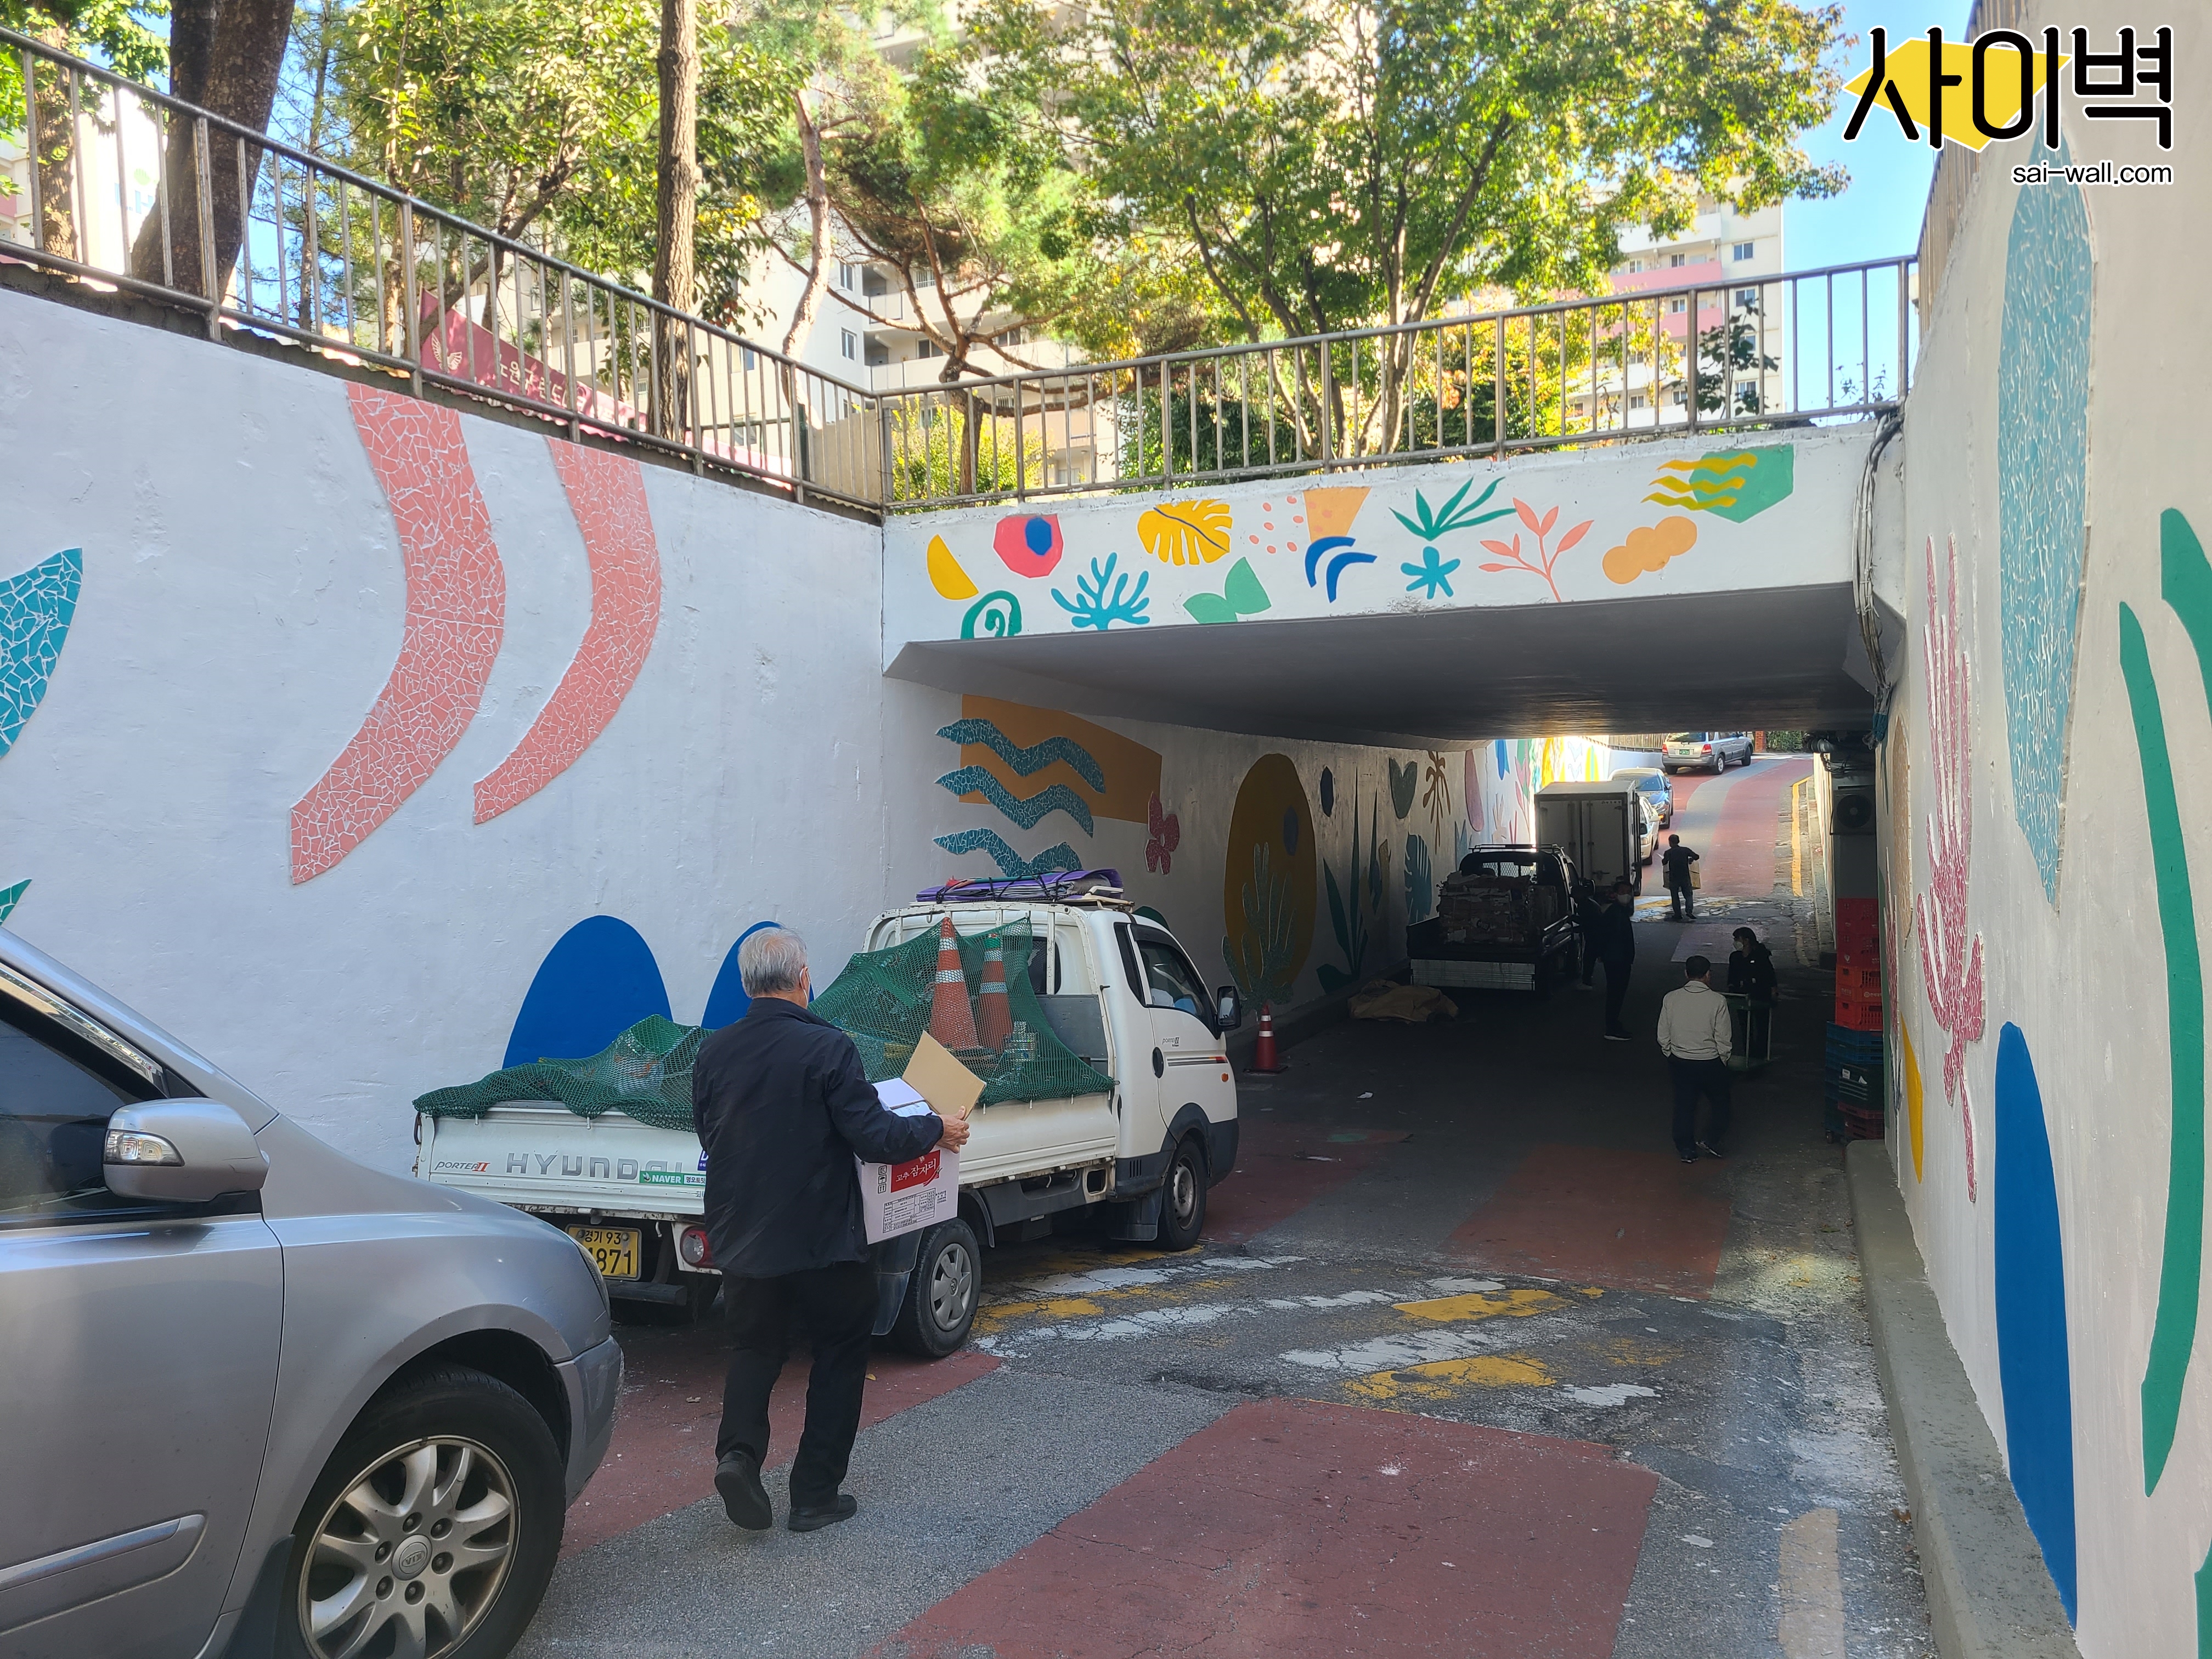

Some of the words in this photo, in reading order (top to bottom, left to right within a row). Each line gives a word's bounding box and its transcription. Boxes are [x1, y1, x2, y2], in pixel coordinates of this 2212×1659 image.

[652, 1175, 681, 1183] NAVER
[585, 1231, 602, 1243] 경기
[606, 1232, 622, 1245] 93
[588, 1247, 631, 1275] 871
